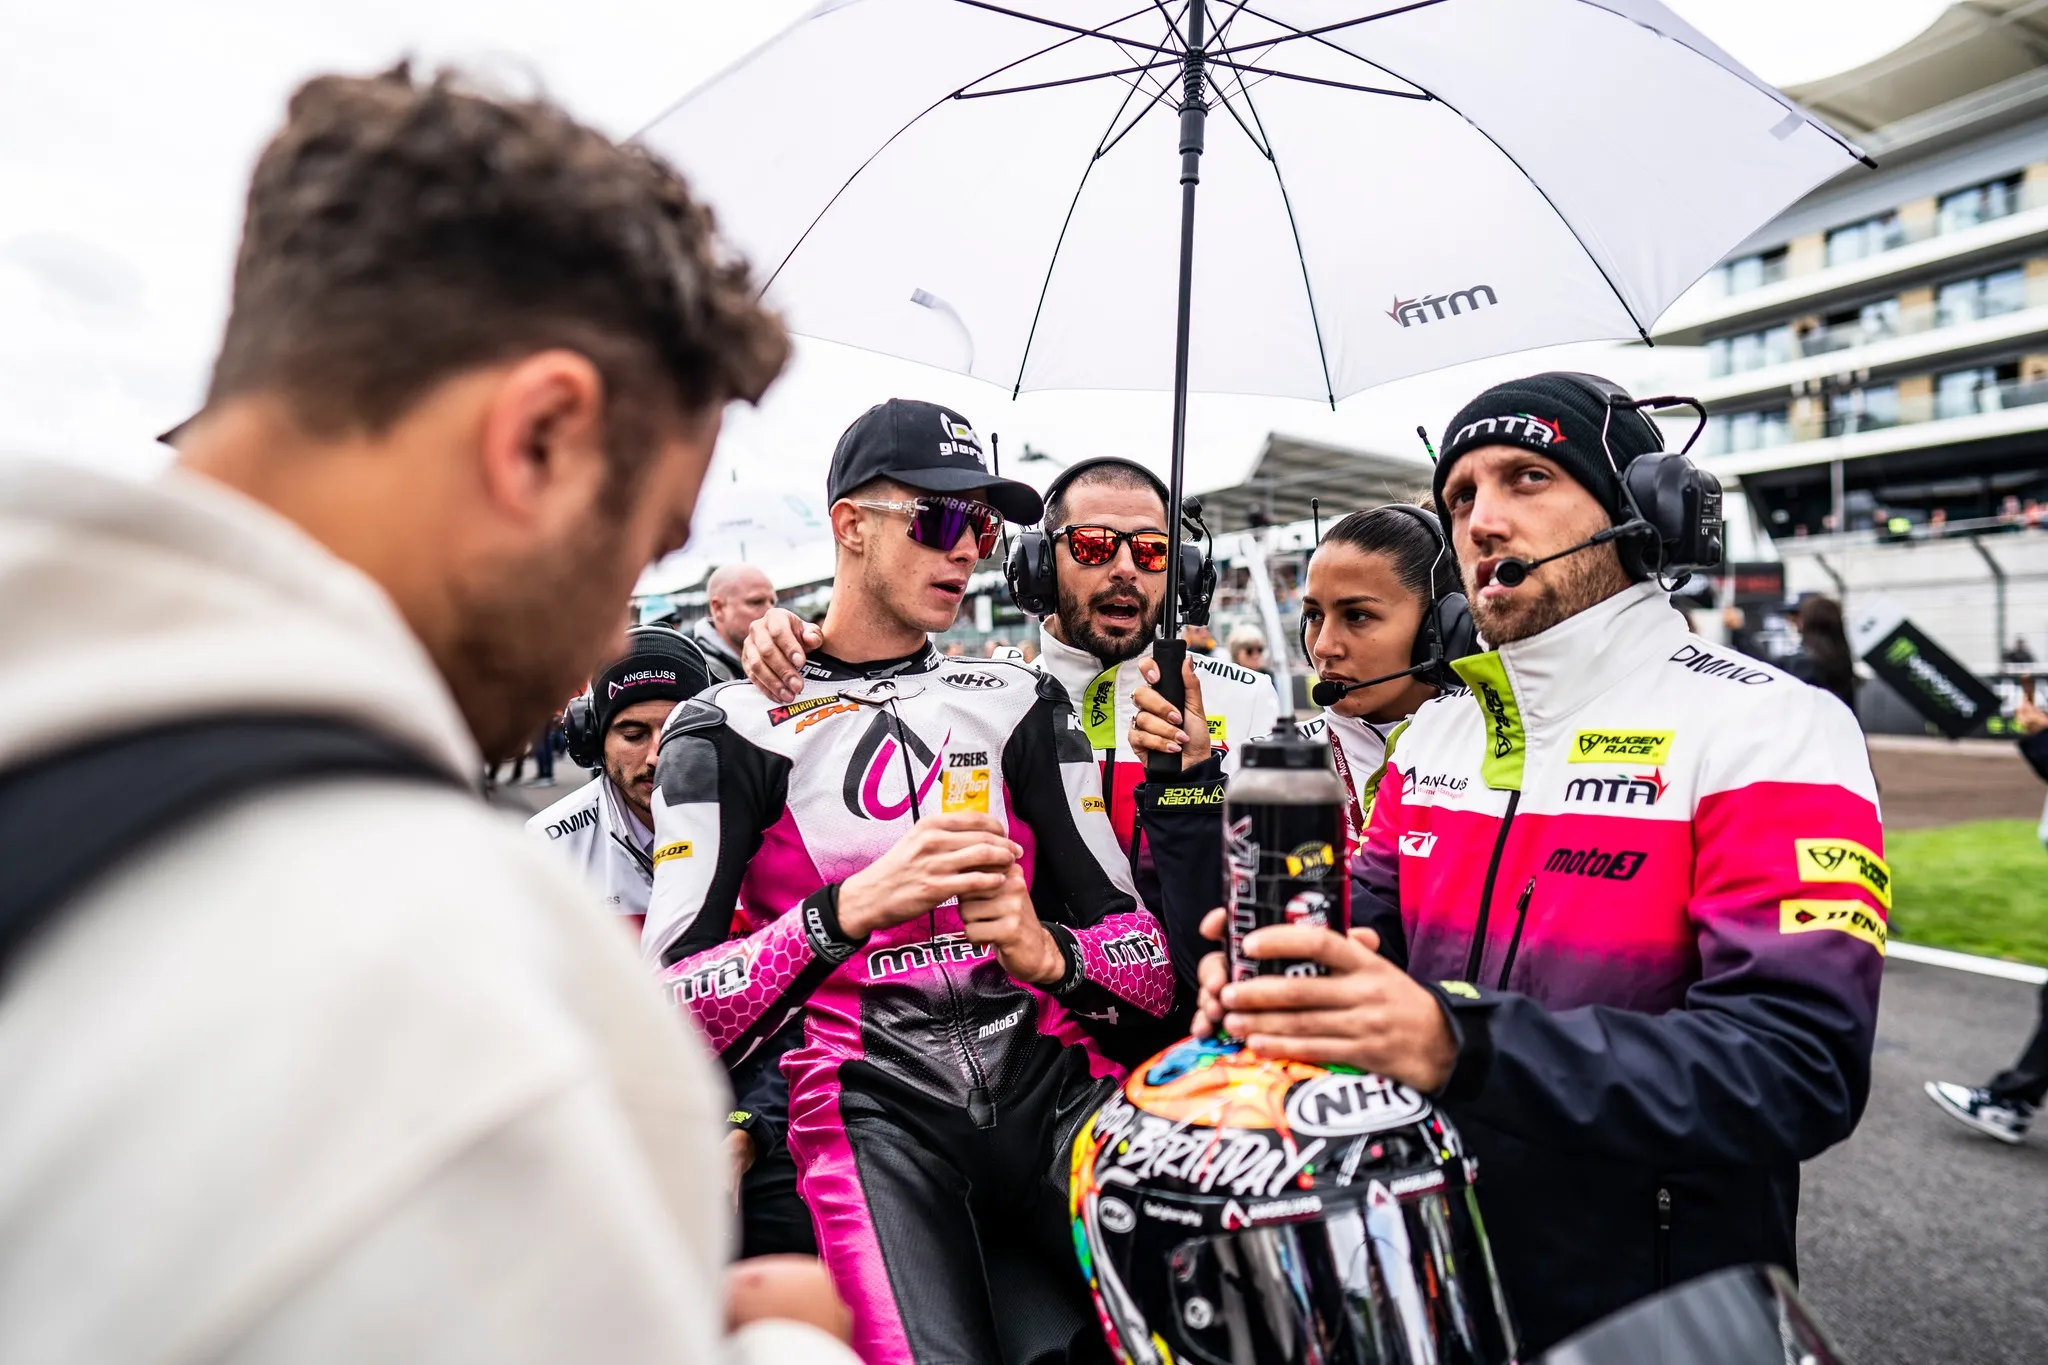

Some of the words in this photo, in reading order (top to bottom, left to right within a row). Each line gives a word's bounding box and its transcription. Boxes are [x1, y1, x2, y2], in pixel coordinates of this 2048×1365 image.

[1452, 415, 1555, 446] MTA
[623, 669, 676, 684] ANGELUSS
[1192, 660, 1256, 685] MIND
[1668, 644, 1775, 685] DMIND
[942, 673, 1004, 688] NHK
[795, 703, 859, 734] KTM
[1600, 735, 1665, 746] MUGEN
[1603, 745, 1653, 755] RACE
[949, 751, 988, 768] 226ERS
[1157, 794, 1210, 806] MUGEN
[1163, 787, 1205, 798] RACE
[1564, 776, 1661, 806] MTA
[545, 807, 598, 841] DMIN
[1544, 848, 1648, 882] moto3
[870, 939, 984, 977] MTA
[1116, 1116, 1327, 1198] BIRTHDAY
